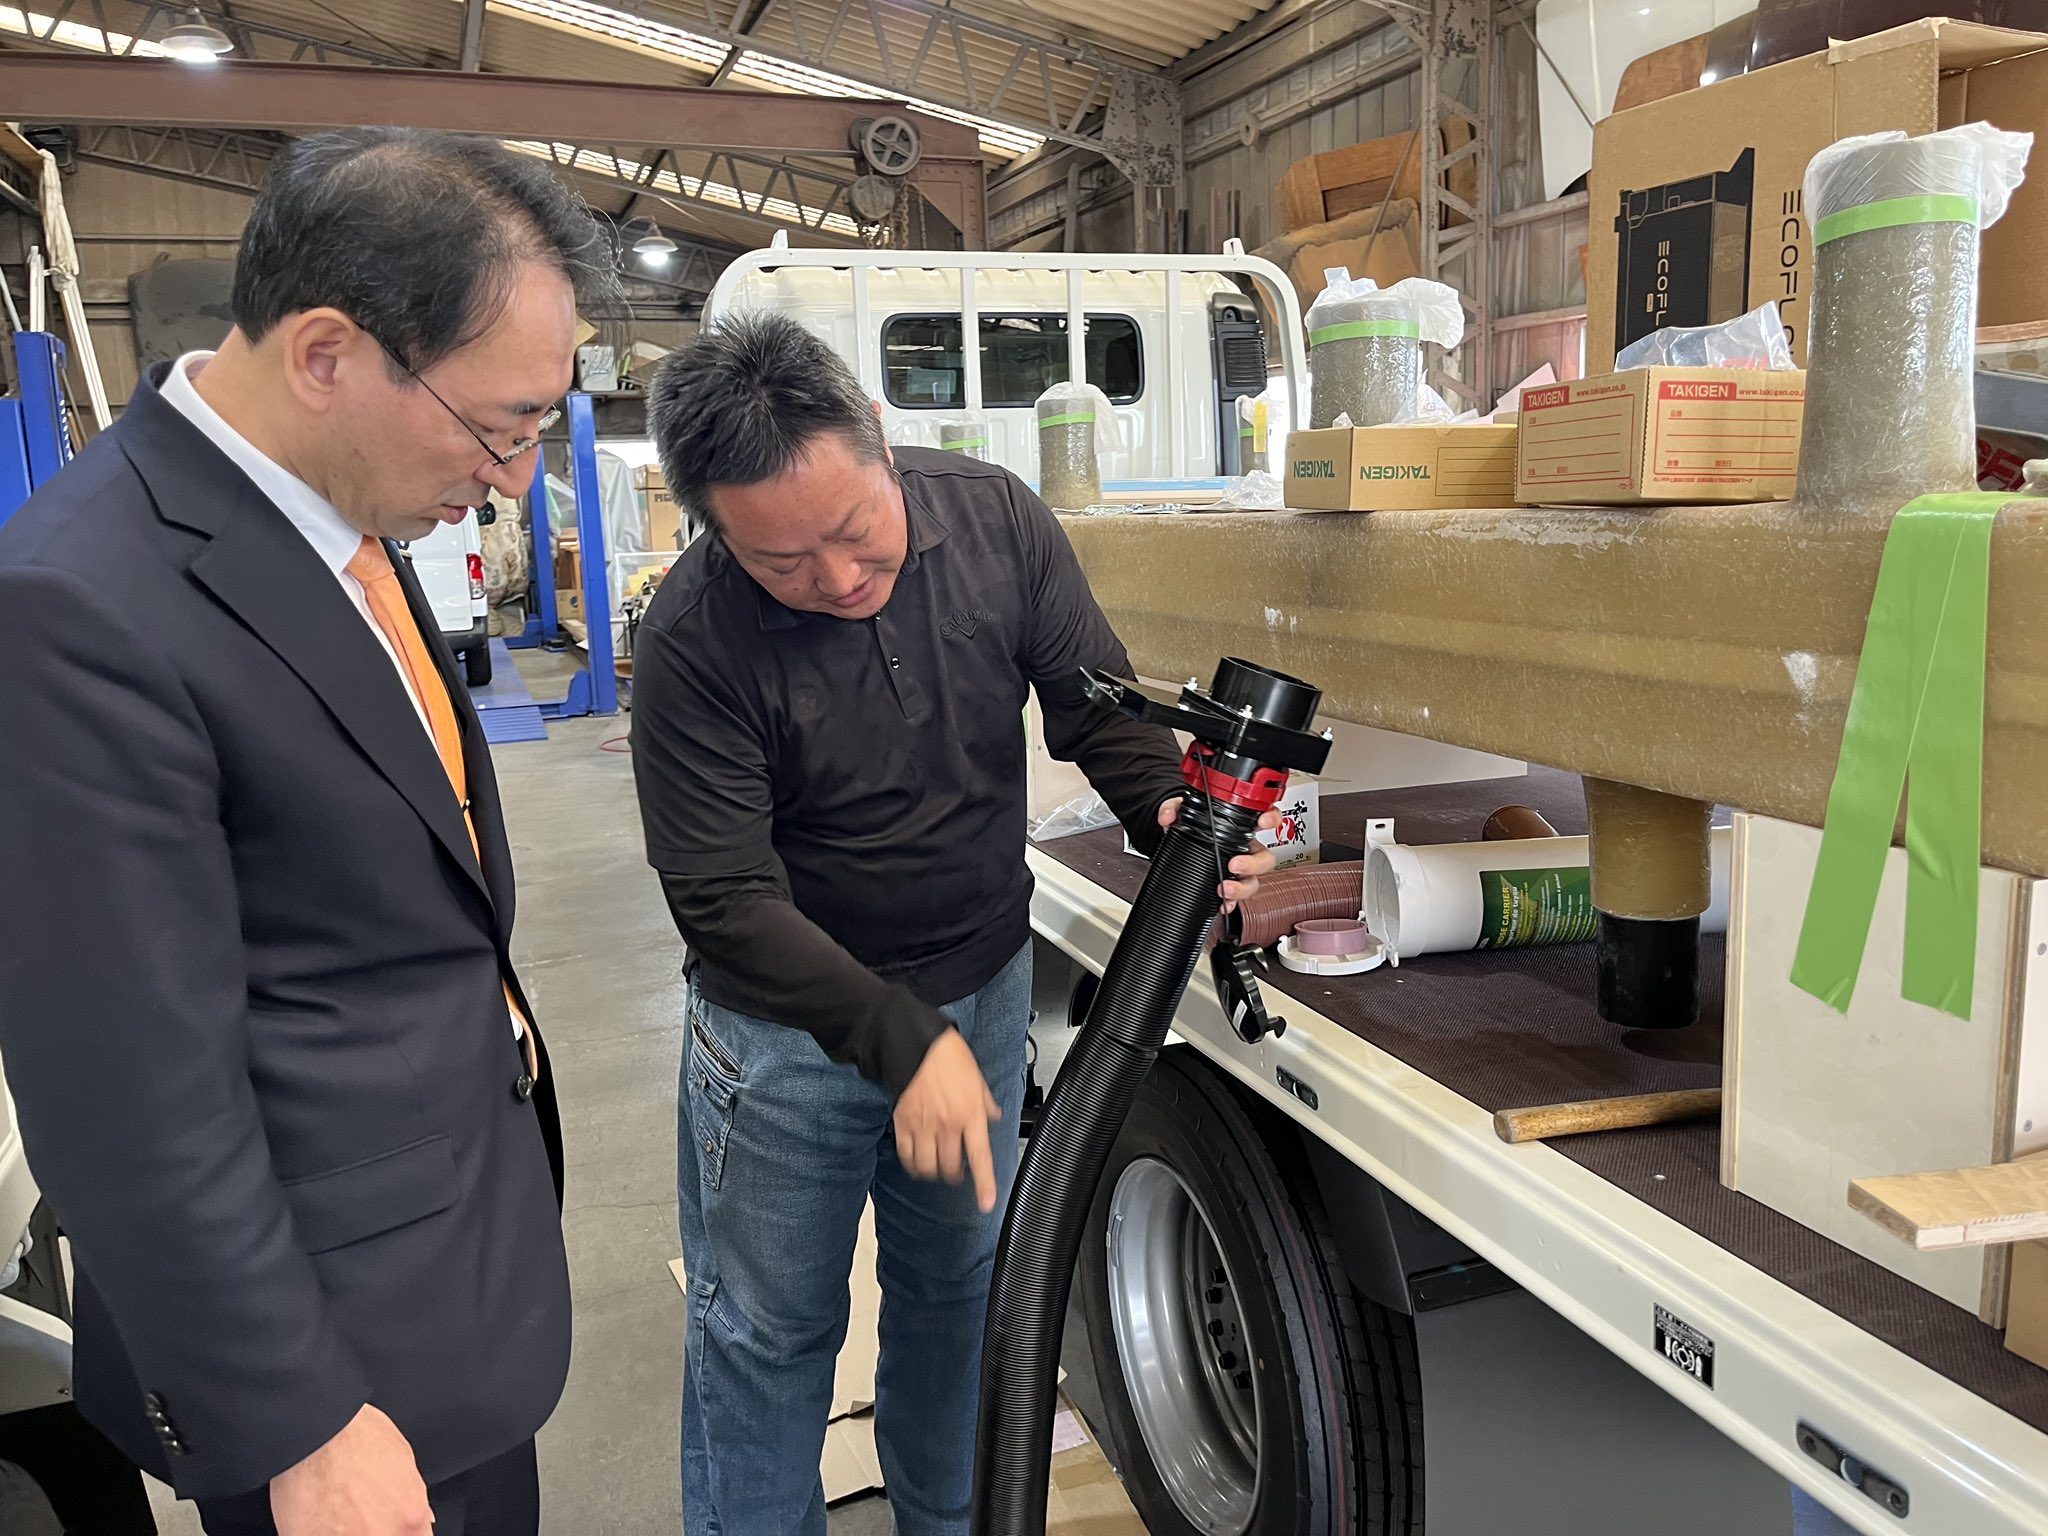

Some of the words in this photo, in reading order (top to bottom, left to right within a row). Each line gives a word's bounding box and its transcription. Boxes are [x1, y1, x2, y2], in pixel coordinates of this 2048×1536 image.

[1779, 189, 1803, 357] ECOFL
[1528, 390, 1565, 408] TAKIGEN
[1576, 383, 1626, 397] www.takigen.co.jp
[1667, 384, 1729, 398] TAKIGEN
[1293, 460, 1336, 478] TAKIGEN
[1360, 465, 1431, 480] TAKIGEN
[1502, 886, 1510, 926] CARRIER
